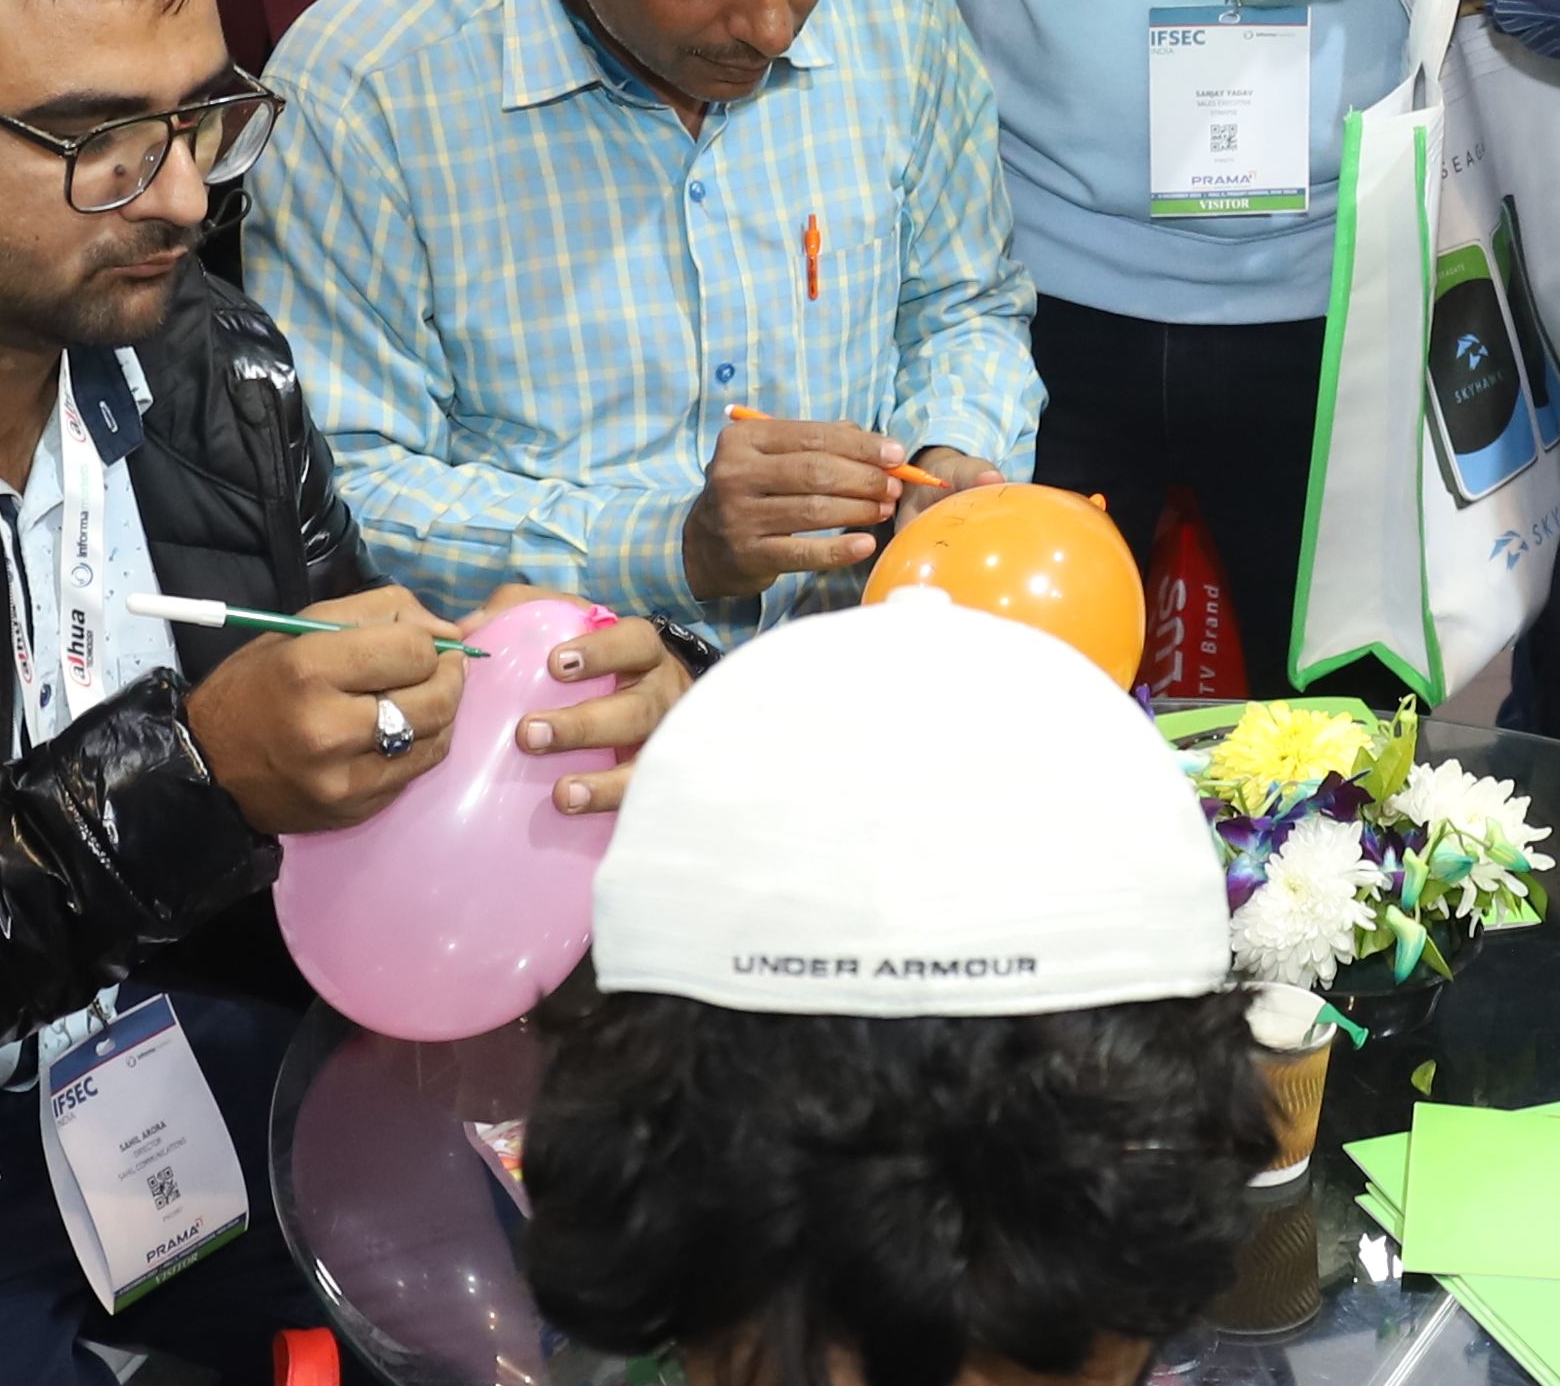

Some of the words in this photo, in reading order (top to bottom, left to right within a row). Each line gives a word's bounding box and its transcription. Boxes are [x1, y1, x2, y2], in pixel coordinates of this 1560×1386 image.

[1150, 29, 1207, 47] IFSEC
[1191, 174, 1252, 186] PRAMA
[1199, 198, 1250, 210] VISITOR
[1200, 584, 1220, 655] Brand
[732, 955, 858, 977] UNDER
[873, 956, 1038, 979] ARMOUR
[52, 1076, 100, 1119] IFSEC
[146, 1225, 200, 1264] PRAMA
